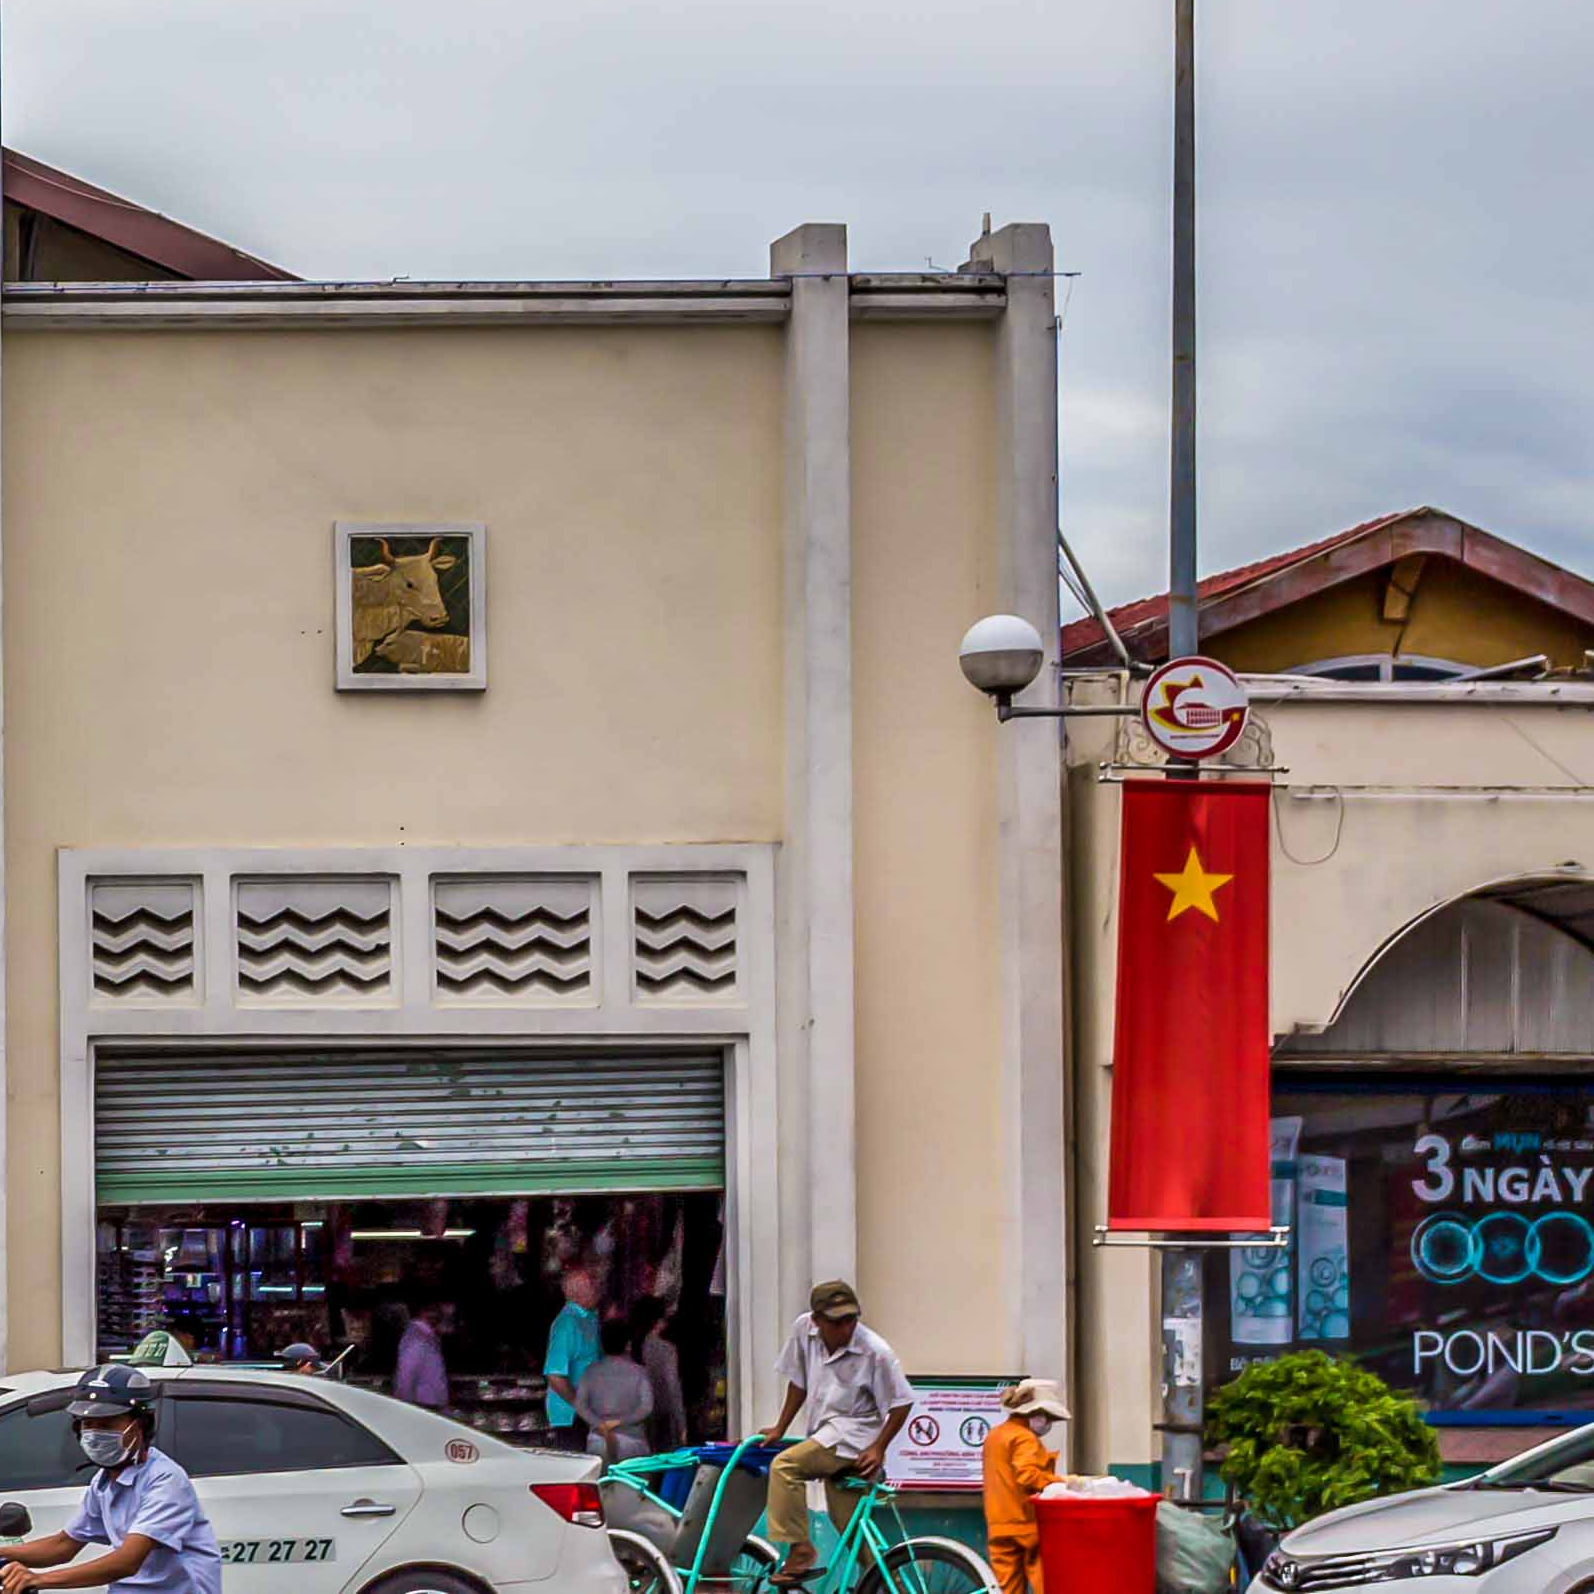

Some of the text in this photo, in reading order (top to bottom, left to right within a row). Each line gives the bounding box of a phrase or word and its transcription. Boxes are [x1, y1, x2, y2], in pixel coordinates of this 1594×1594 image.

[1412, 1134, 1594, 1203] 3 NGÀY
[1413, 1329, 1594, 1374] POND'S
[232, 1538, 333, 1563] 27 27 27
